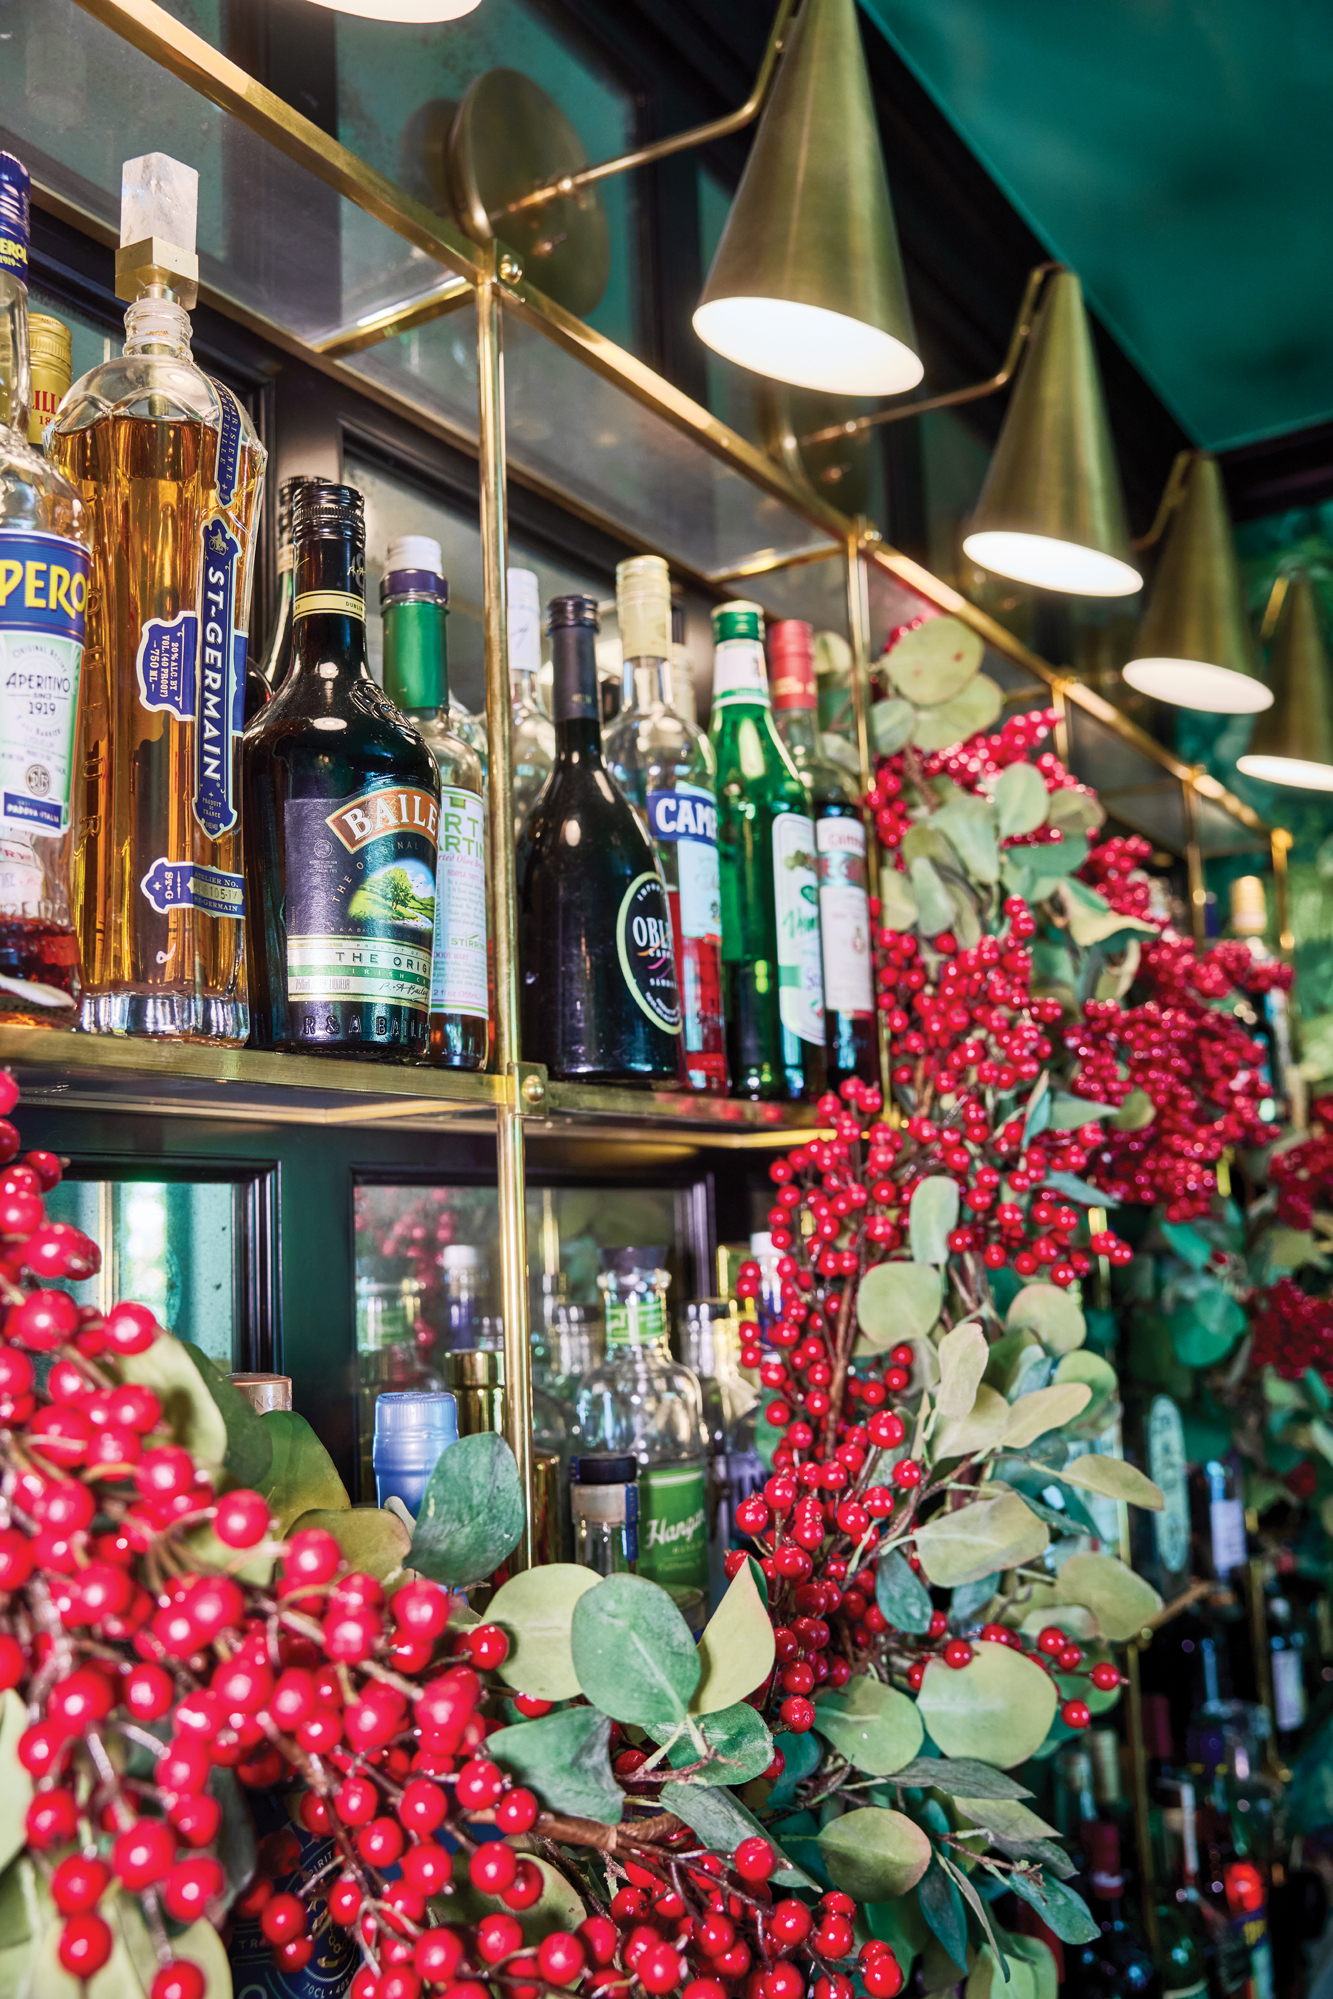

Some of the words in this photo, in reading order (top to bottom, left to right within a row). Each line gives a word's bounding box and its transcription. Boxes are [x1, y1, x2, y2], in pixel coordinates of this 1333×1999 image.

[0, 237, 28, 266] EROL
[39, 416, 52, 425] 18
[149, 649, 160, 669] 750
[6, 672, 71, 693] APERITIVO
[28, 701, 56, 717] 1919
[202, 808, 221, 819] FRANCE
[341, 794, 438, 841] BAILE
[193, 871, 222, 885] ATELIER
[335, 952, 379, 963] THE
[352, 968, 405, 979] IRISH
[303, 1015, 316, 1035] R
[325, 1015, 340, 1035] &
[349, 1015, 362, 1034] A
[308, 1850, 334, 1877] PIRIT
